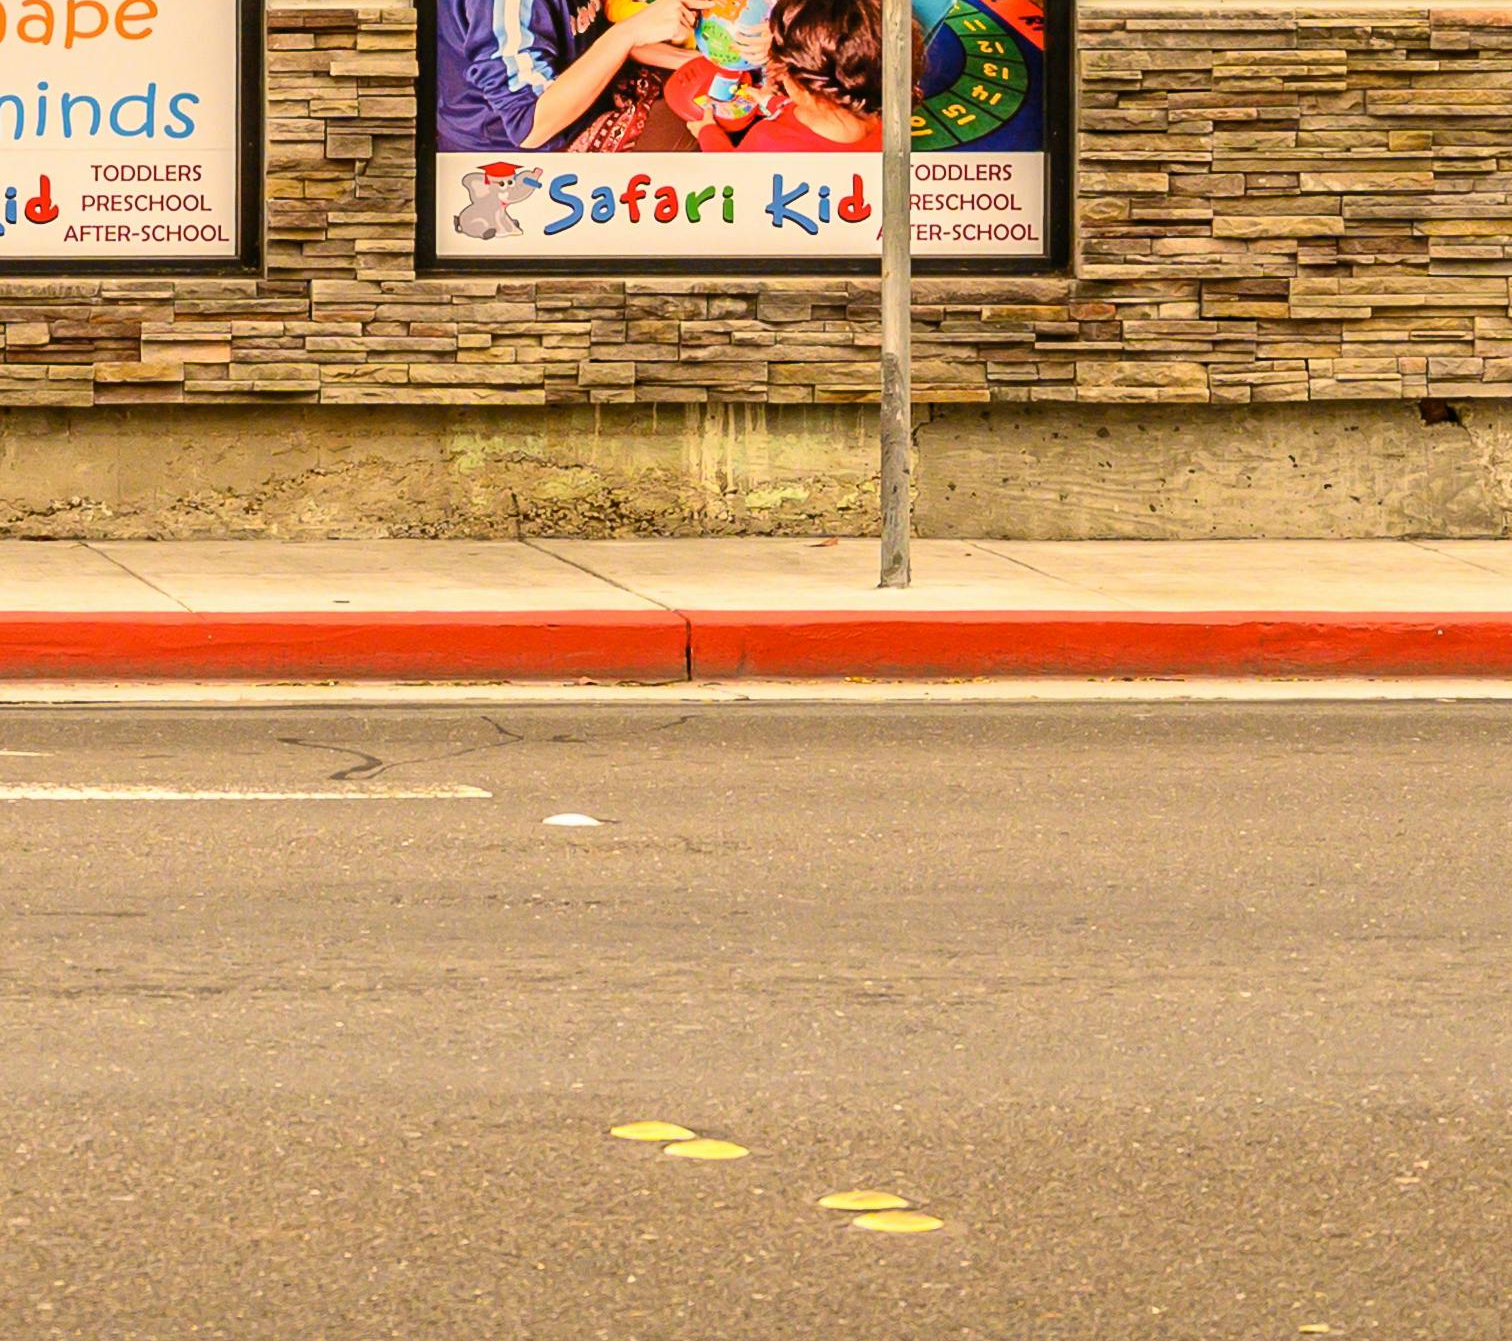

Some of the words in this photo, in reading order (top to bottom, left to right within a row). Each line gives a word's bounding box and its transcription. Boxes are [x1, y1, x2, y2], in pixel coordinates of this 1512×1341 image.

[91, 164, 202, 183] TODDLERS
[910, 164, 1013, 182] ODDLERS
[82, 194, 212, 213] PRESCHOOL
[542, 173, 736, 237] Safari
[765, 173, 872, 236] Kid
[910, 193, 1023, 211] RESCHOOL
[64, 224, 229, 243] AFTER-SCHOOL
[877, 223, 1039, 242] ER-SCHOOL
